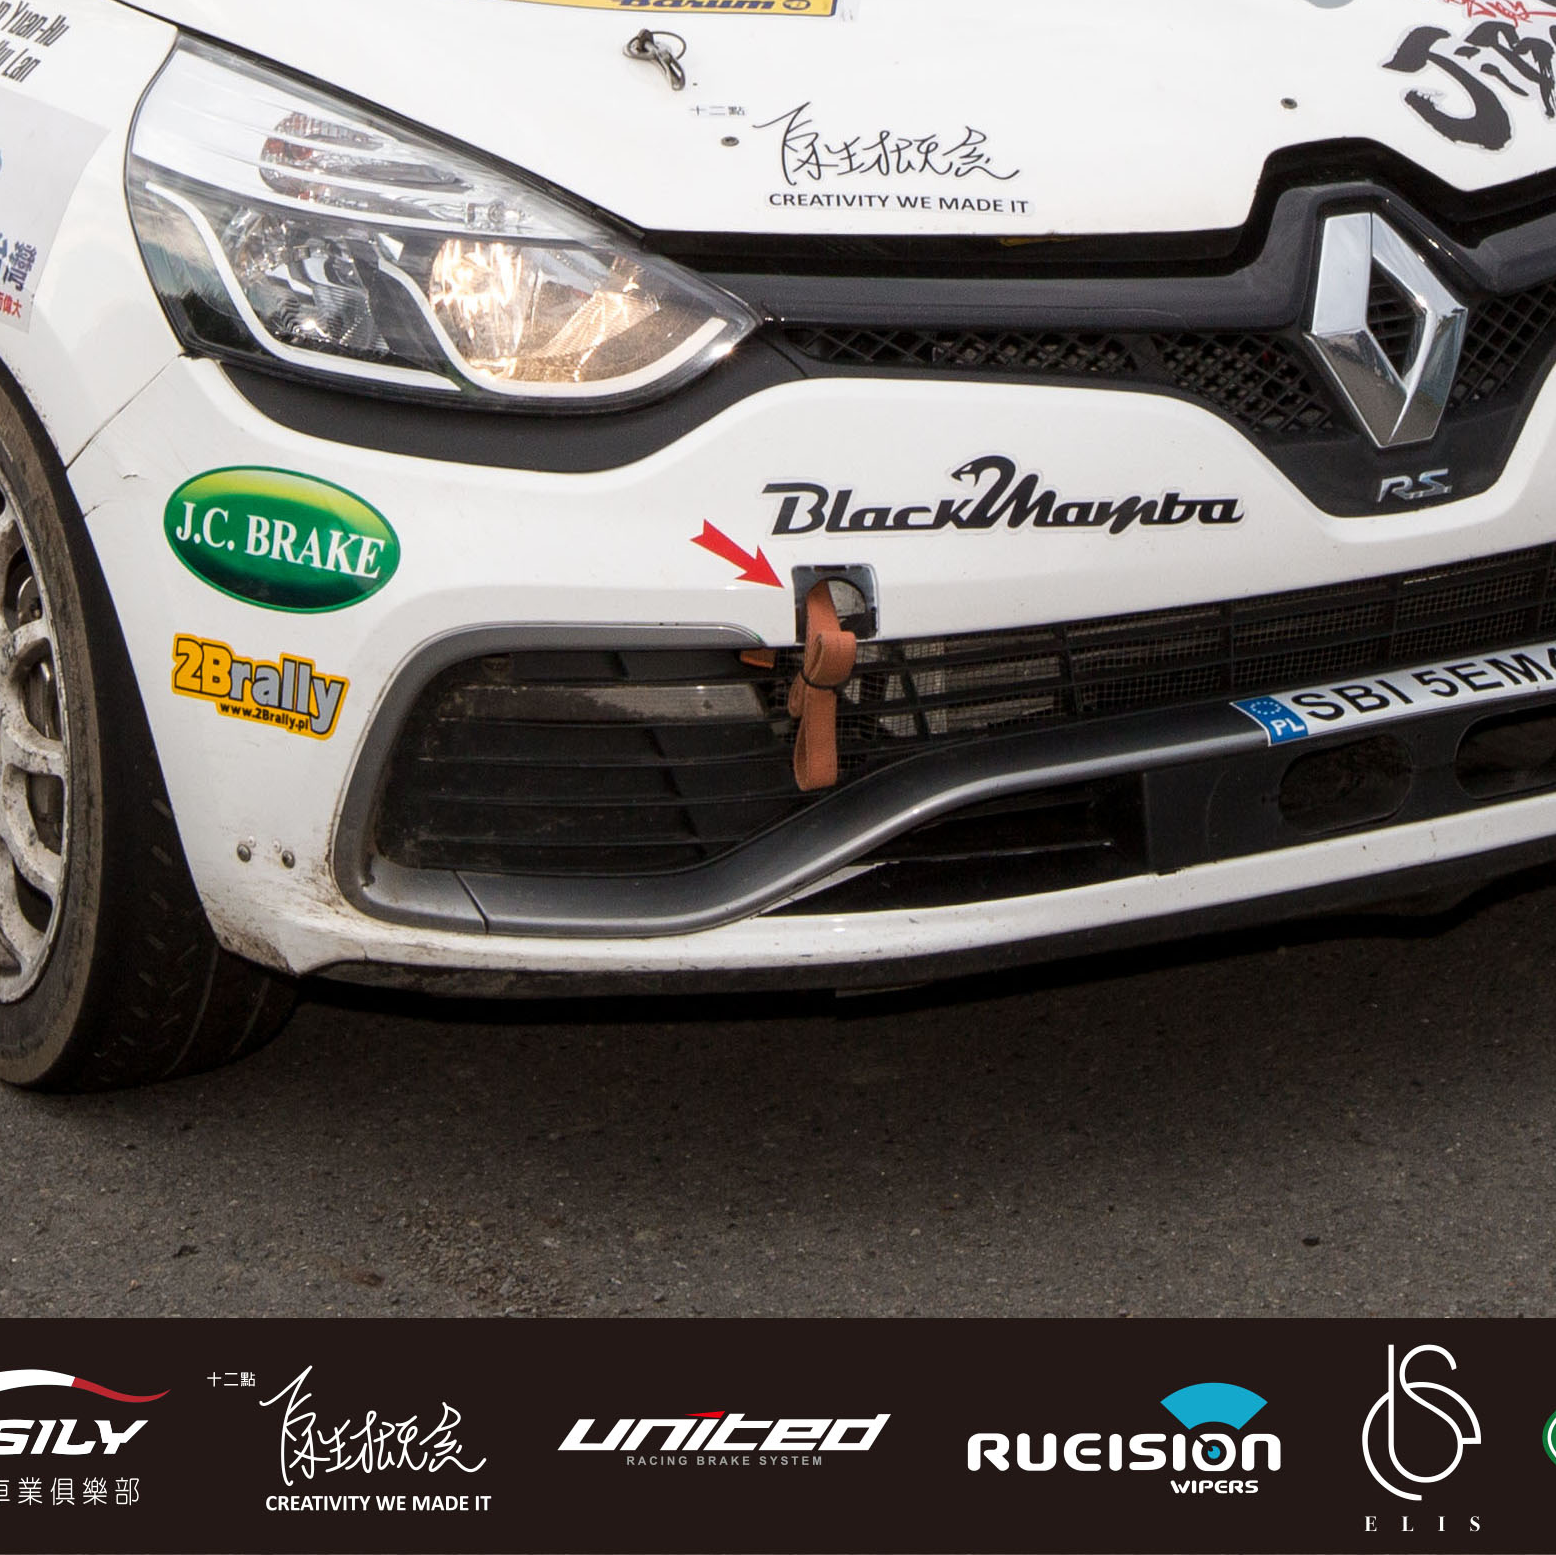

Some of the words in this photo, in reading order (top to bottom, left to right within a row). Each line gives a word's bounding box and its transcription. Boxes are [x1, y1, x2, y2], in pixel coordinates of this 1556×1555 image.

[1, 0, 71, 48] Yuan-Hu
[1, 47, 41, 83] Lan
[768, 193, 890, 209] CREATIVITY
[896, 194, 932, 210] WE
[938, 196, 1004, 212] MADE
[1010, 199, 1030, 214] IT
[761, 454, 1245, 536] BlackMamba
[1375, 468, 1452, 502] RS
[175, 501, 235, 551] J.C.
[244, 513, 387, 580] BRAKE
[173, 635, 347, 736] 2Brally
[1270, 717, 1306, 736] PL
[1291, 680, 1414, 722] SBI
[220, 701, 310, 732] www.2Brally.pl
